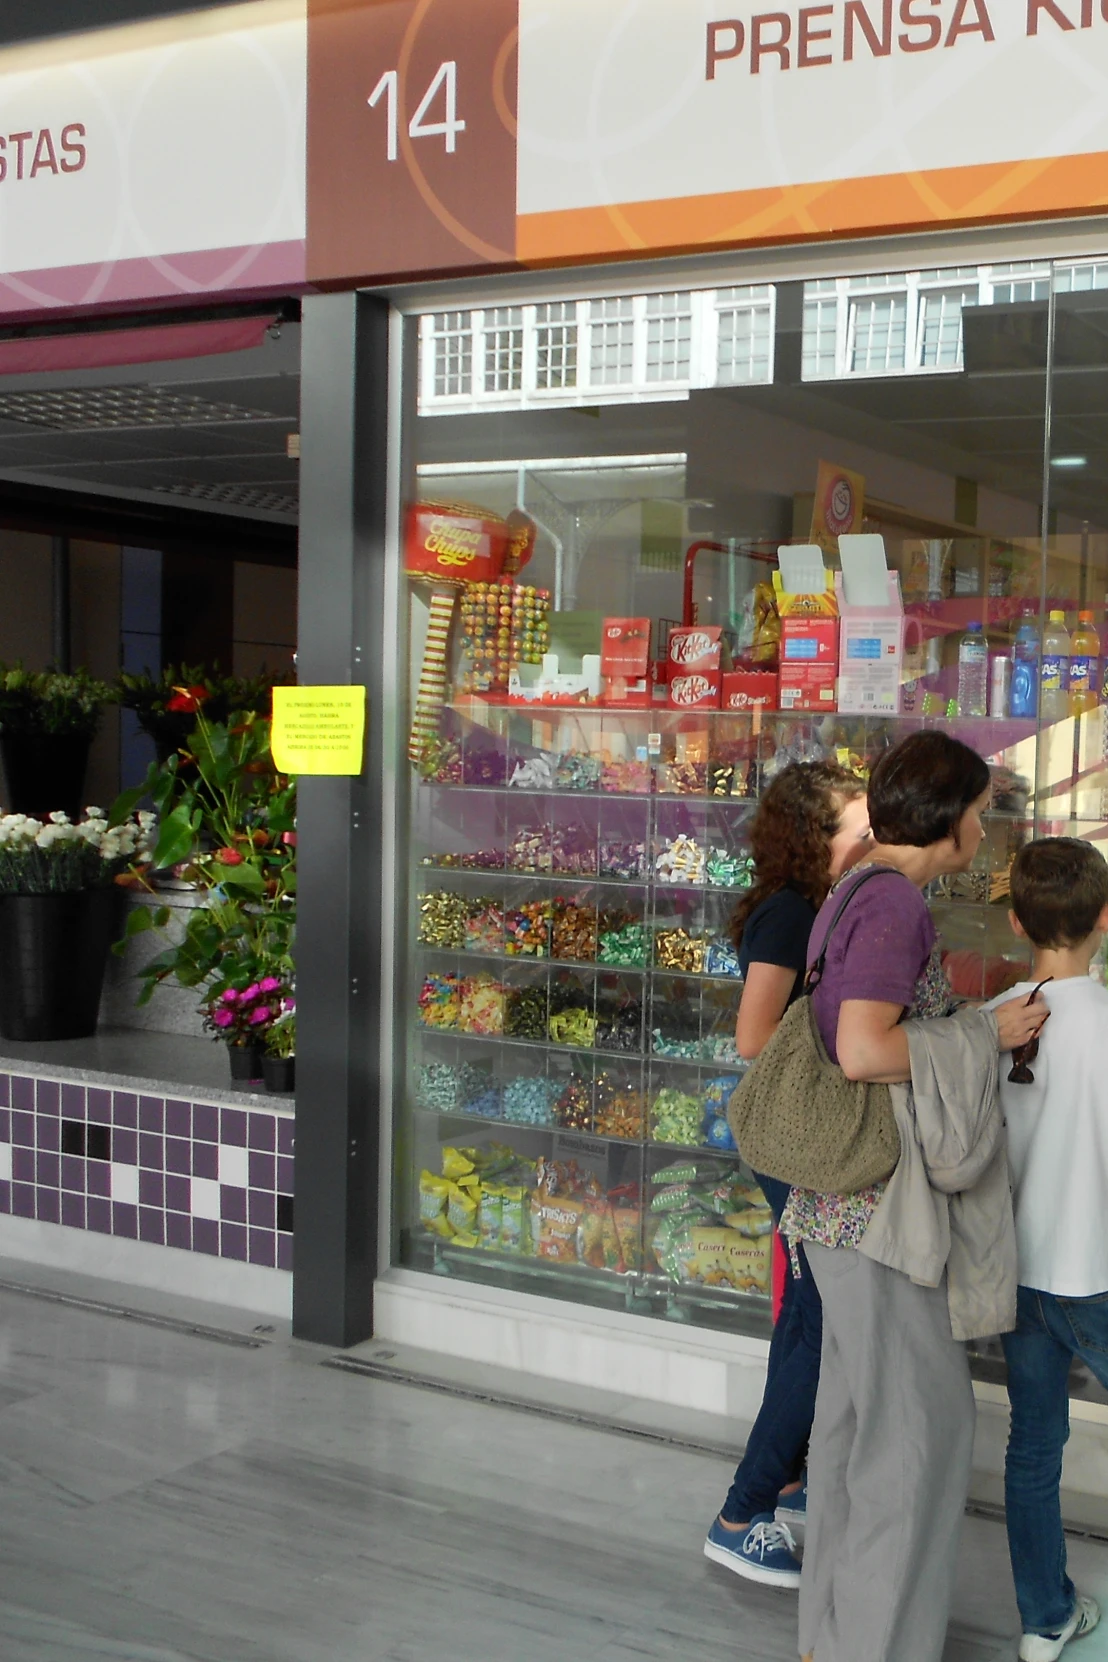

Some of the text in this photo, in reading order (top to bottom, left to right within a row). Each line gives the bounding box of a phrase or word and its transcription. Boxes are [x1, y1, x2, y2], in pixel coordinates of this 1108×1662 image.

[704, 0, 995, 80] PRENSA
[367, 60, 466, 161] 14
[425, 533, 477, 566] Chups
[430, 518, 482, 545] Chupa
